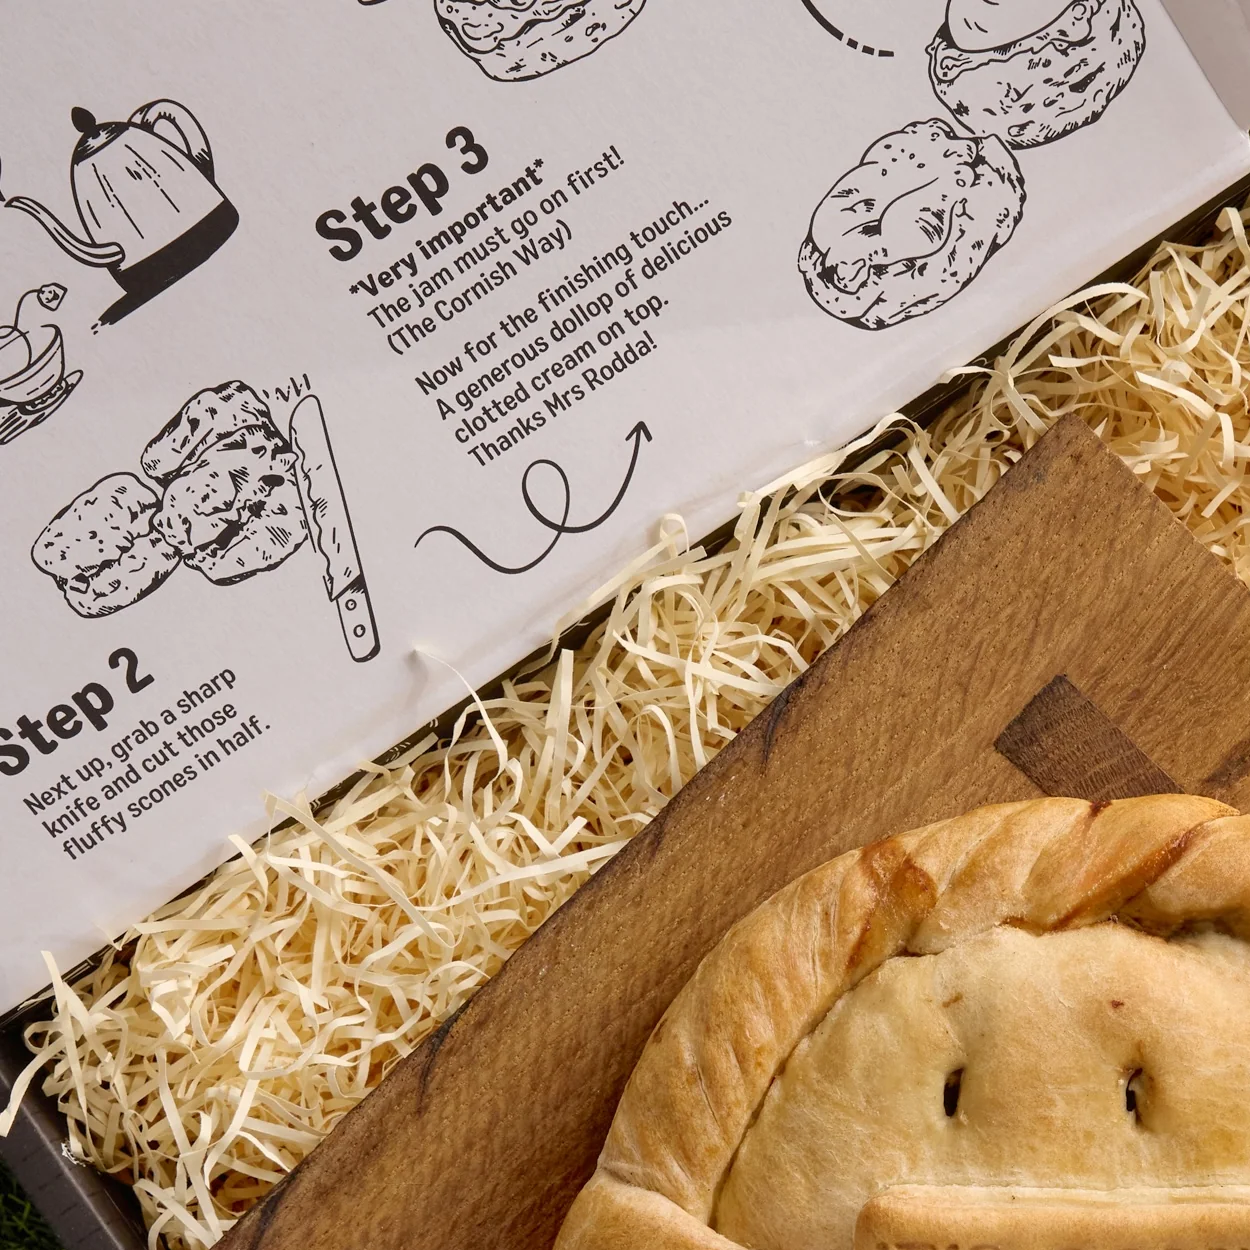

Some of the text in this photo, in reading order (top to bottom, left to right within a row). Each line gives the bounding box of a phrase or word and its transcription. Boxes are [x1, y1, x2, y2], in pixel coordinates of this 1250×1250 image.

[315, 125, 489, 262] Step 3
[366, 144, 625, 329] The jam must go on first!
[387, 218, 572, 356] (The Cornish Way)
[414, 199, 709, 396] Now for the finishing touch...
[436, 210, 732, 421] A generous dollop of delicious
[454, 295, 669, 444] clotted cream on top.
[467, 329, 658, 467] Thanks Mrs Rodda!
[0, 647, 155, 777] Step 2
[22, 668, 236, 816] Next up, grab a sharp
[41, 703, 238, 839] knife and cut those
[62, 714, 271, 860] fluffy scones in half.
